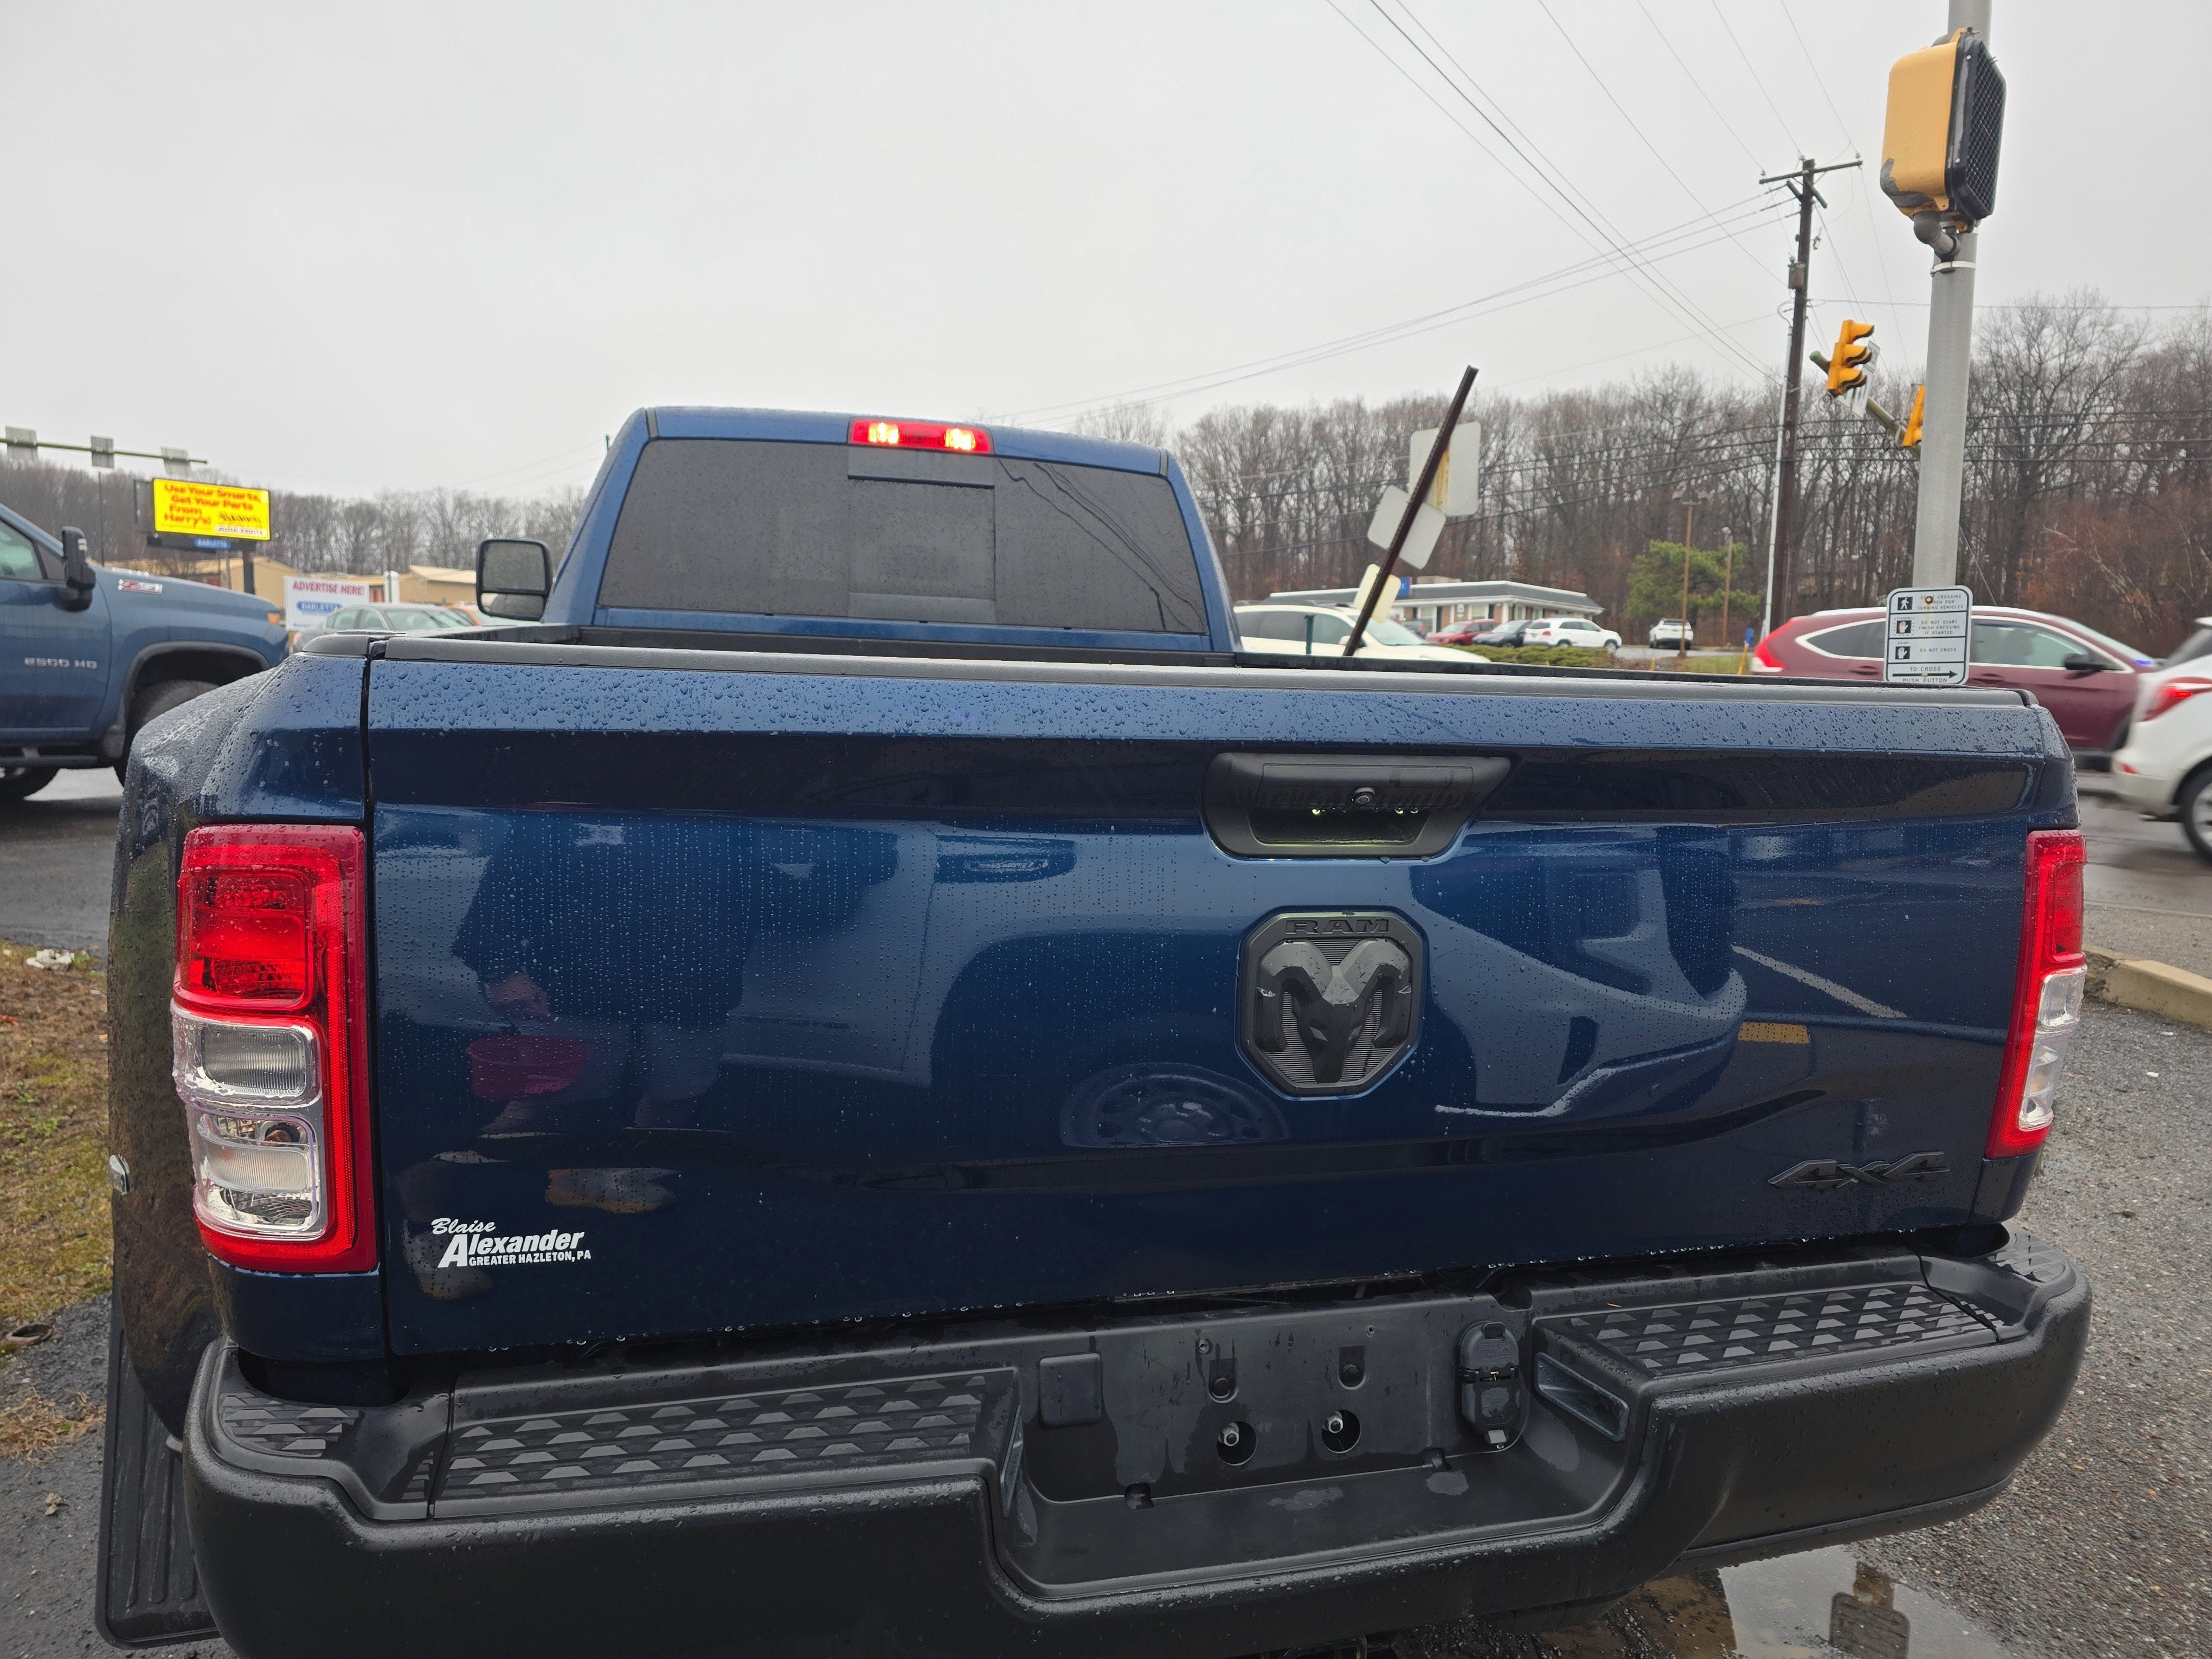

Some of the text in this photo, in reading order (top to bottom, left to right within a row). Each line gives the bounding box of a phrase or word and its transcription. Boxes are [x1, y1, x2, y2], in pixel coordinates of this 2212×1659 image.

[169, 505, 202, 515] From
[293, 580, 338, 594] ADVERTISE
[24, 657, 98, 670] 2500 HD
[1285, 918, 1390, 935] RAM
[431, 1217, 496, 1235] Blaise
[437, 1229, 585, 1268] Alexander
[469, 1249, 591, 1266] GREATER HAZLETON, PA
